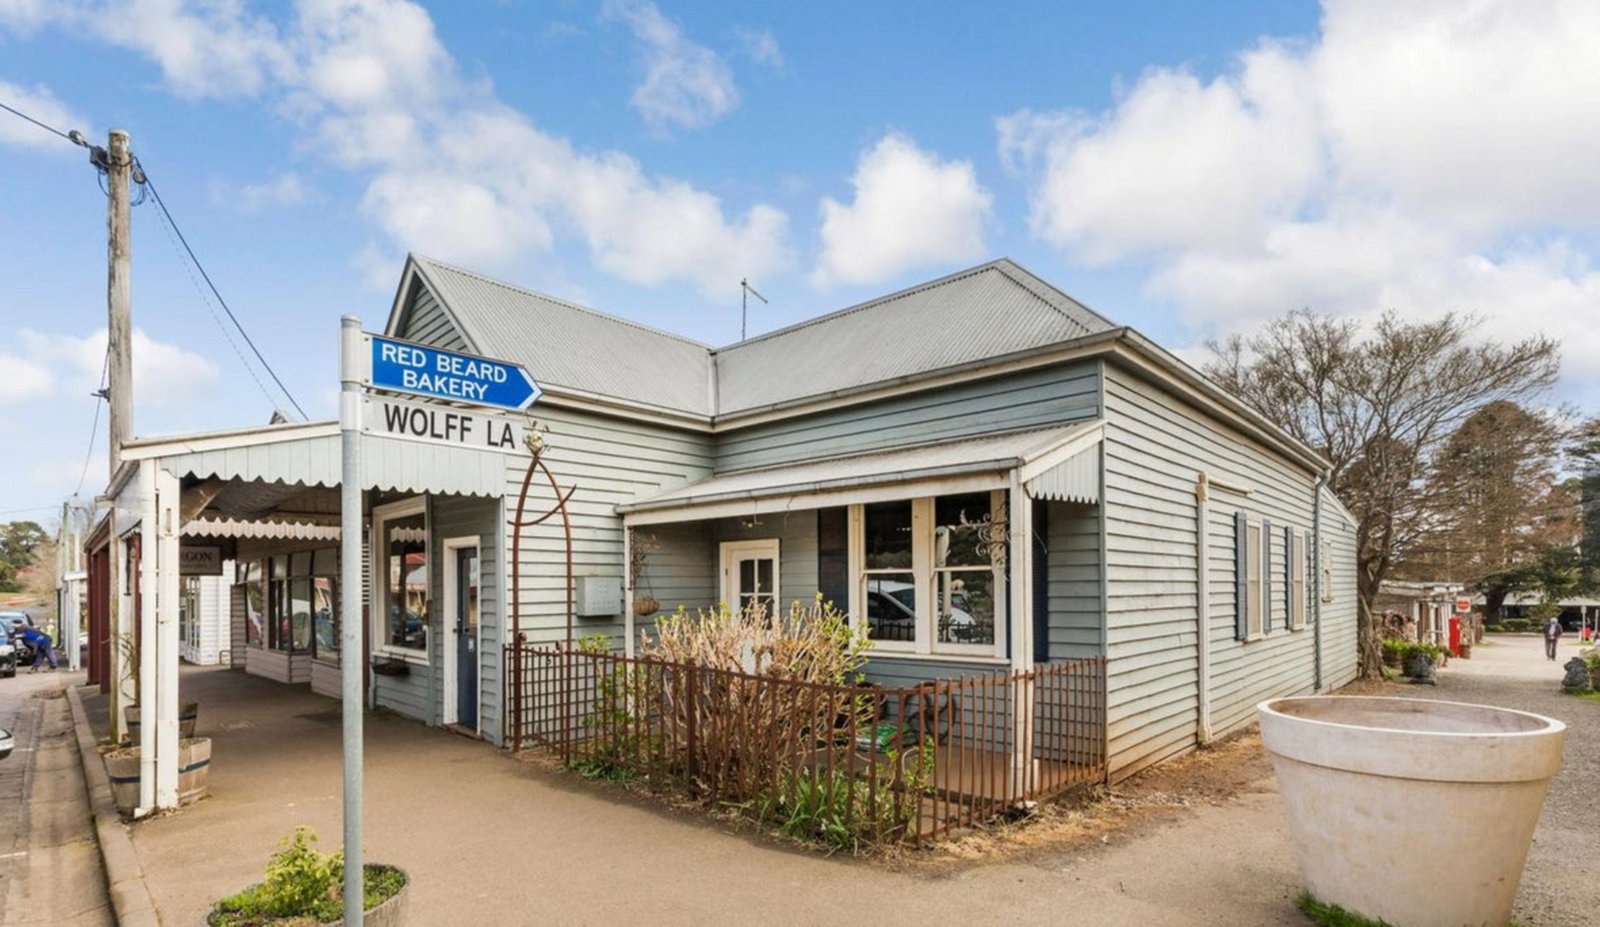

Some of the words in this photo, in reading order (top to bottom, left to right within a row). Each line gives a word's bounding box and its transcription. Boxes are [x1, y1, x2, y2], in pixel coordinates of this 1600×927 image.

[382, 343, 427, 368] RED
[436, 354, 508, 384] BEARD
[403, 370, 489, 400] BAKERY
[384, 403, 473, 442] WOLFF
[487, 420, 516, 450] LA
